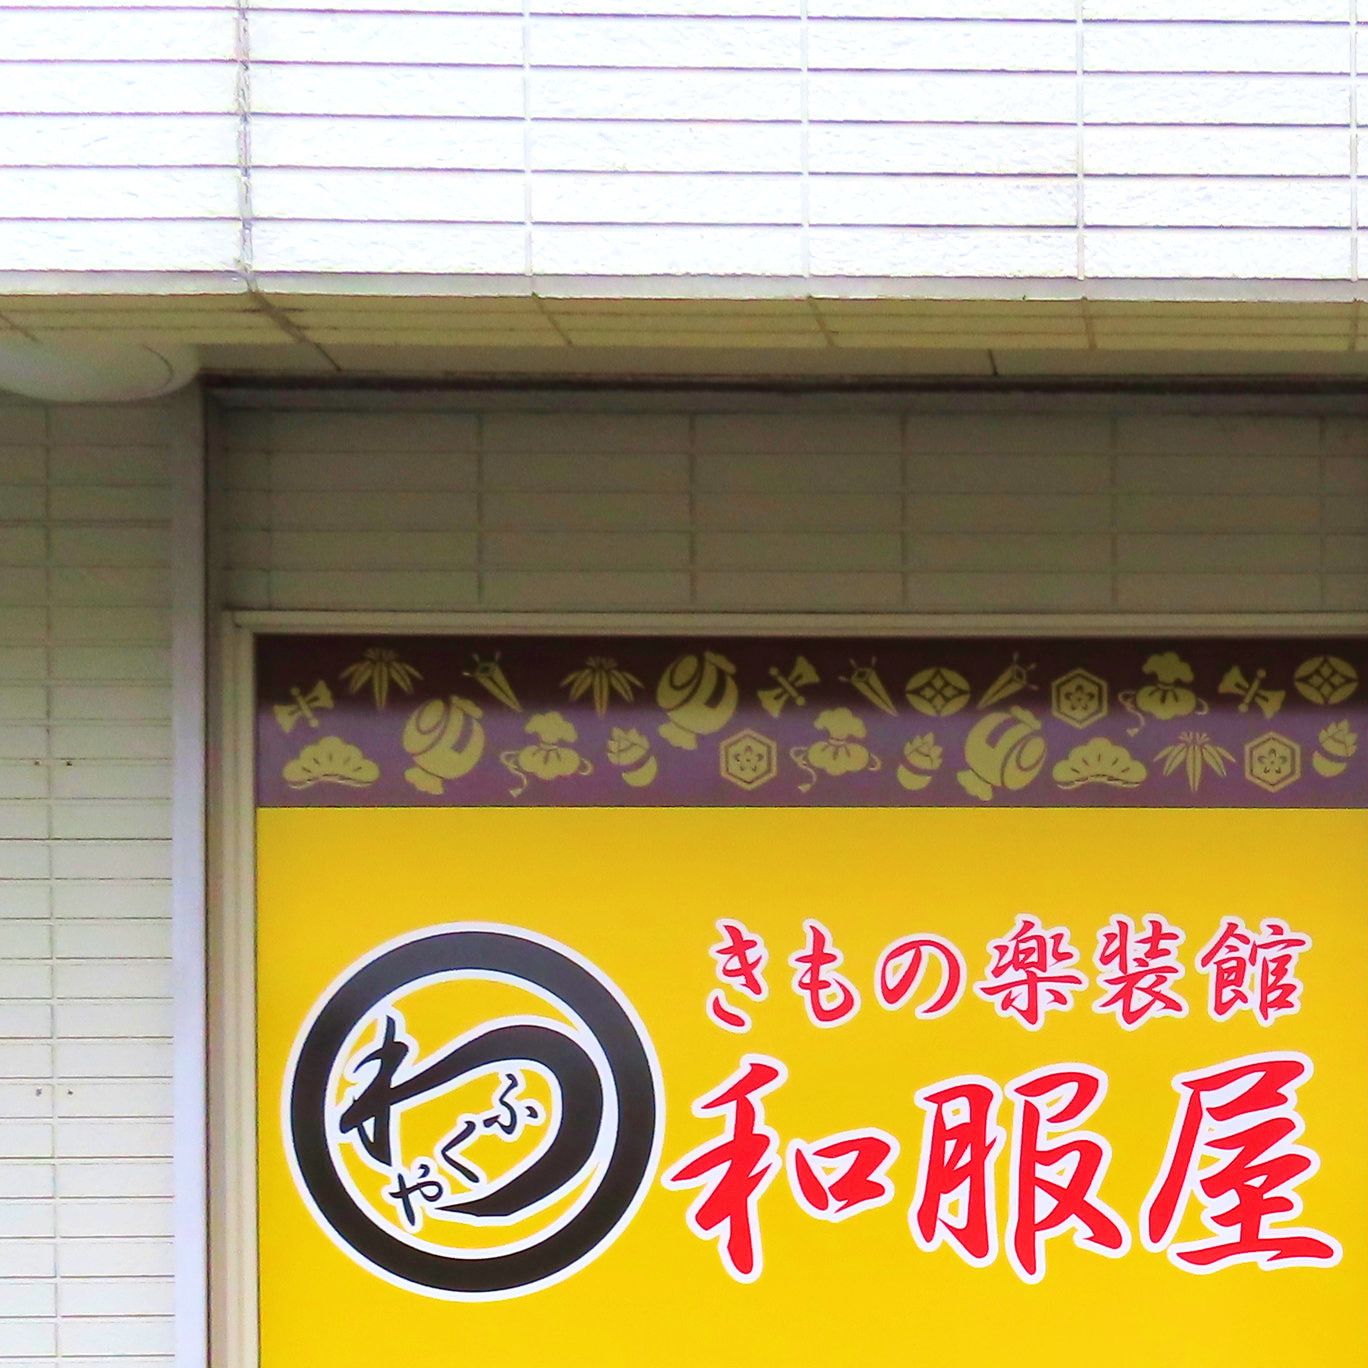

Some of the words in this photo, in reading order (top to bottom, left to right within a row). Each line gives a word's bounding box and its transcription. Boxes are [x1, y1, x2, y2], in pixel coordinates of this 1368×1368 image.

[711, 918, 1308, 1028] きもの楽装館
[669, 1057, 1337, 1277] 和服屋
